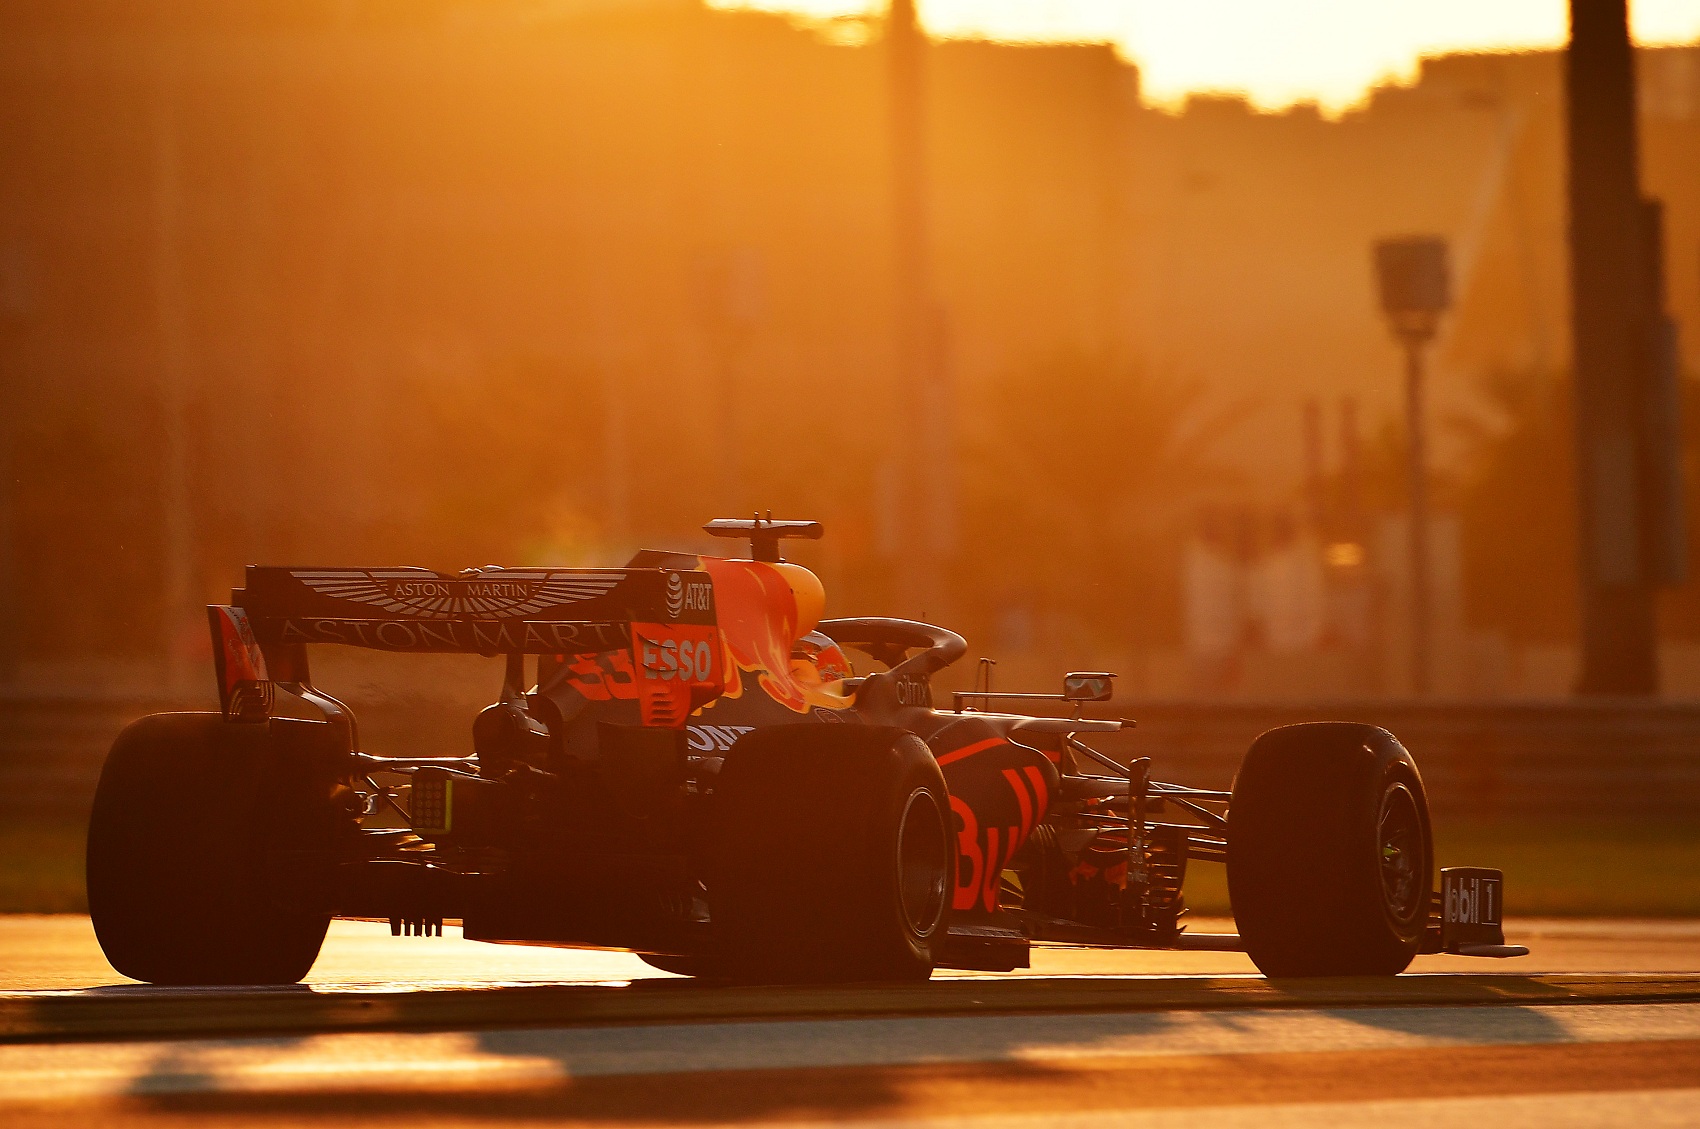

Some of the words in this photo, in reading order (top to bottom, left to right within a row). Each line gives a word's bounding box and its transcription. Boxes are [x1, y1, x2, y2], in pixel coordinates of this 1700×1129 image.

[394, 583, 450, 597] ASTON
[467, 584, 528, 597] MARTIN
[684, 583, 712, 610] AT&T
[280, 620, 461, 648] ASTON
[472, 623, 631, 649] MARTI
[643, 639, 711, 681] ESSO
